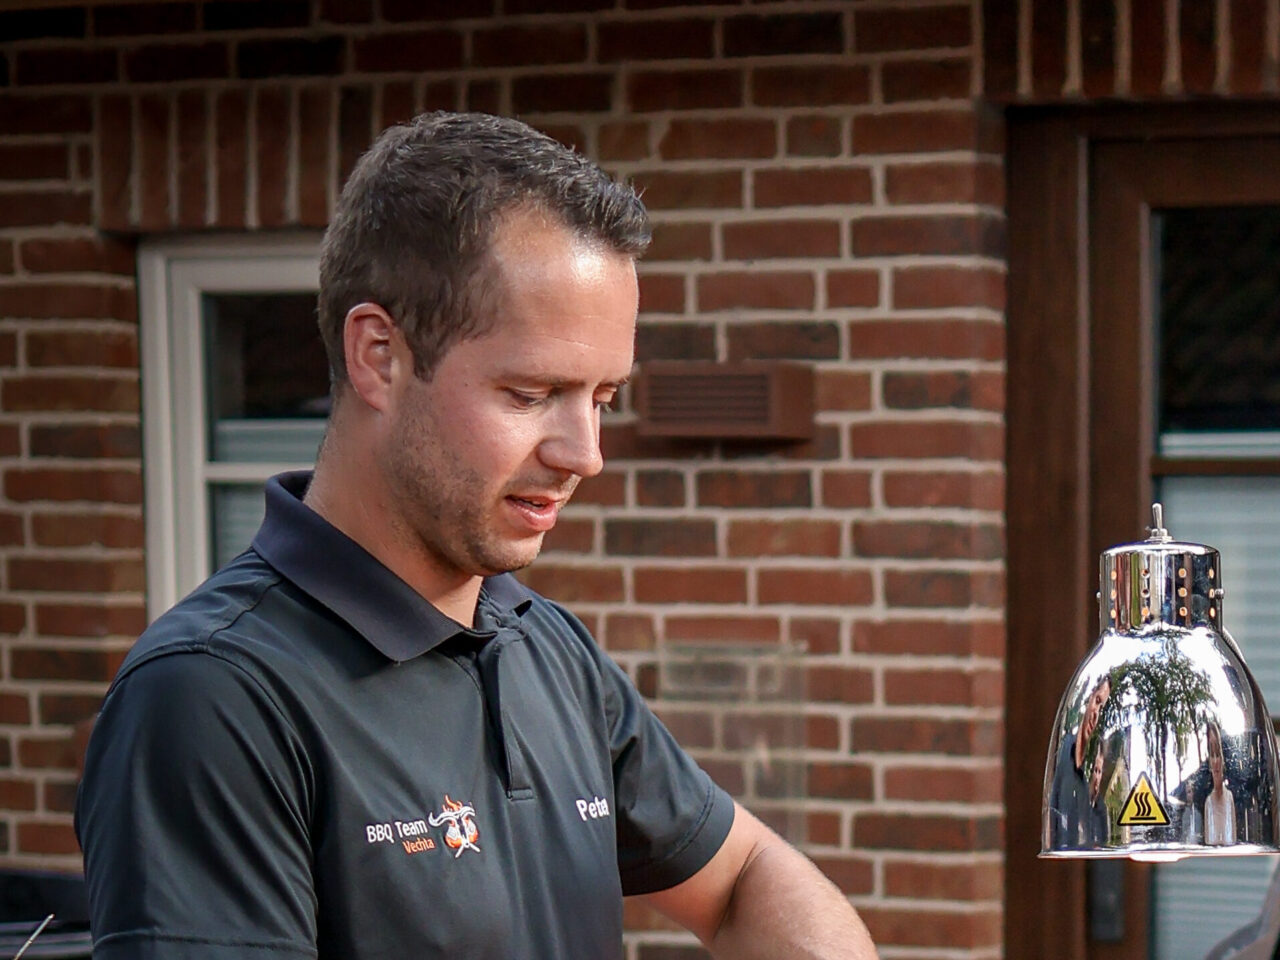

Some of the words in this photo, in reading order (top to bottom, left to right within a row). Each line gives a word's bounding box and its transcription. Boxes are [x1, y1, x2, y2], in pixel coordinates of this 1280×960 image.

[366, 823, 395, 844] BBQ
[395, 820, 428, 838] Team
[402, 836, 436, 854] Vechta
